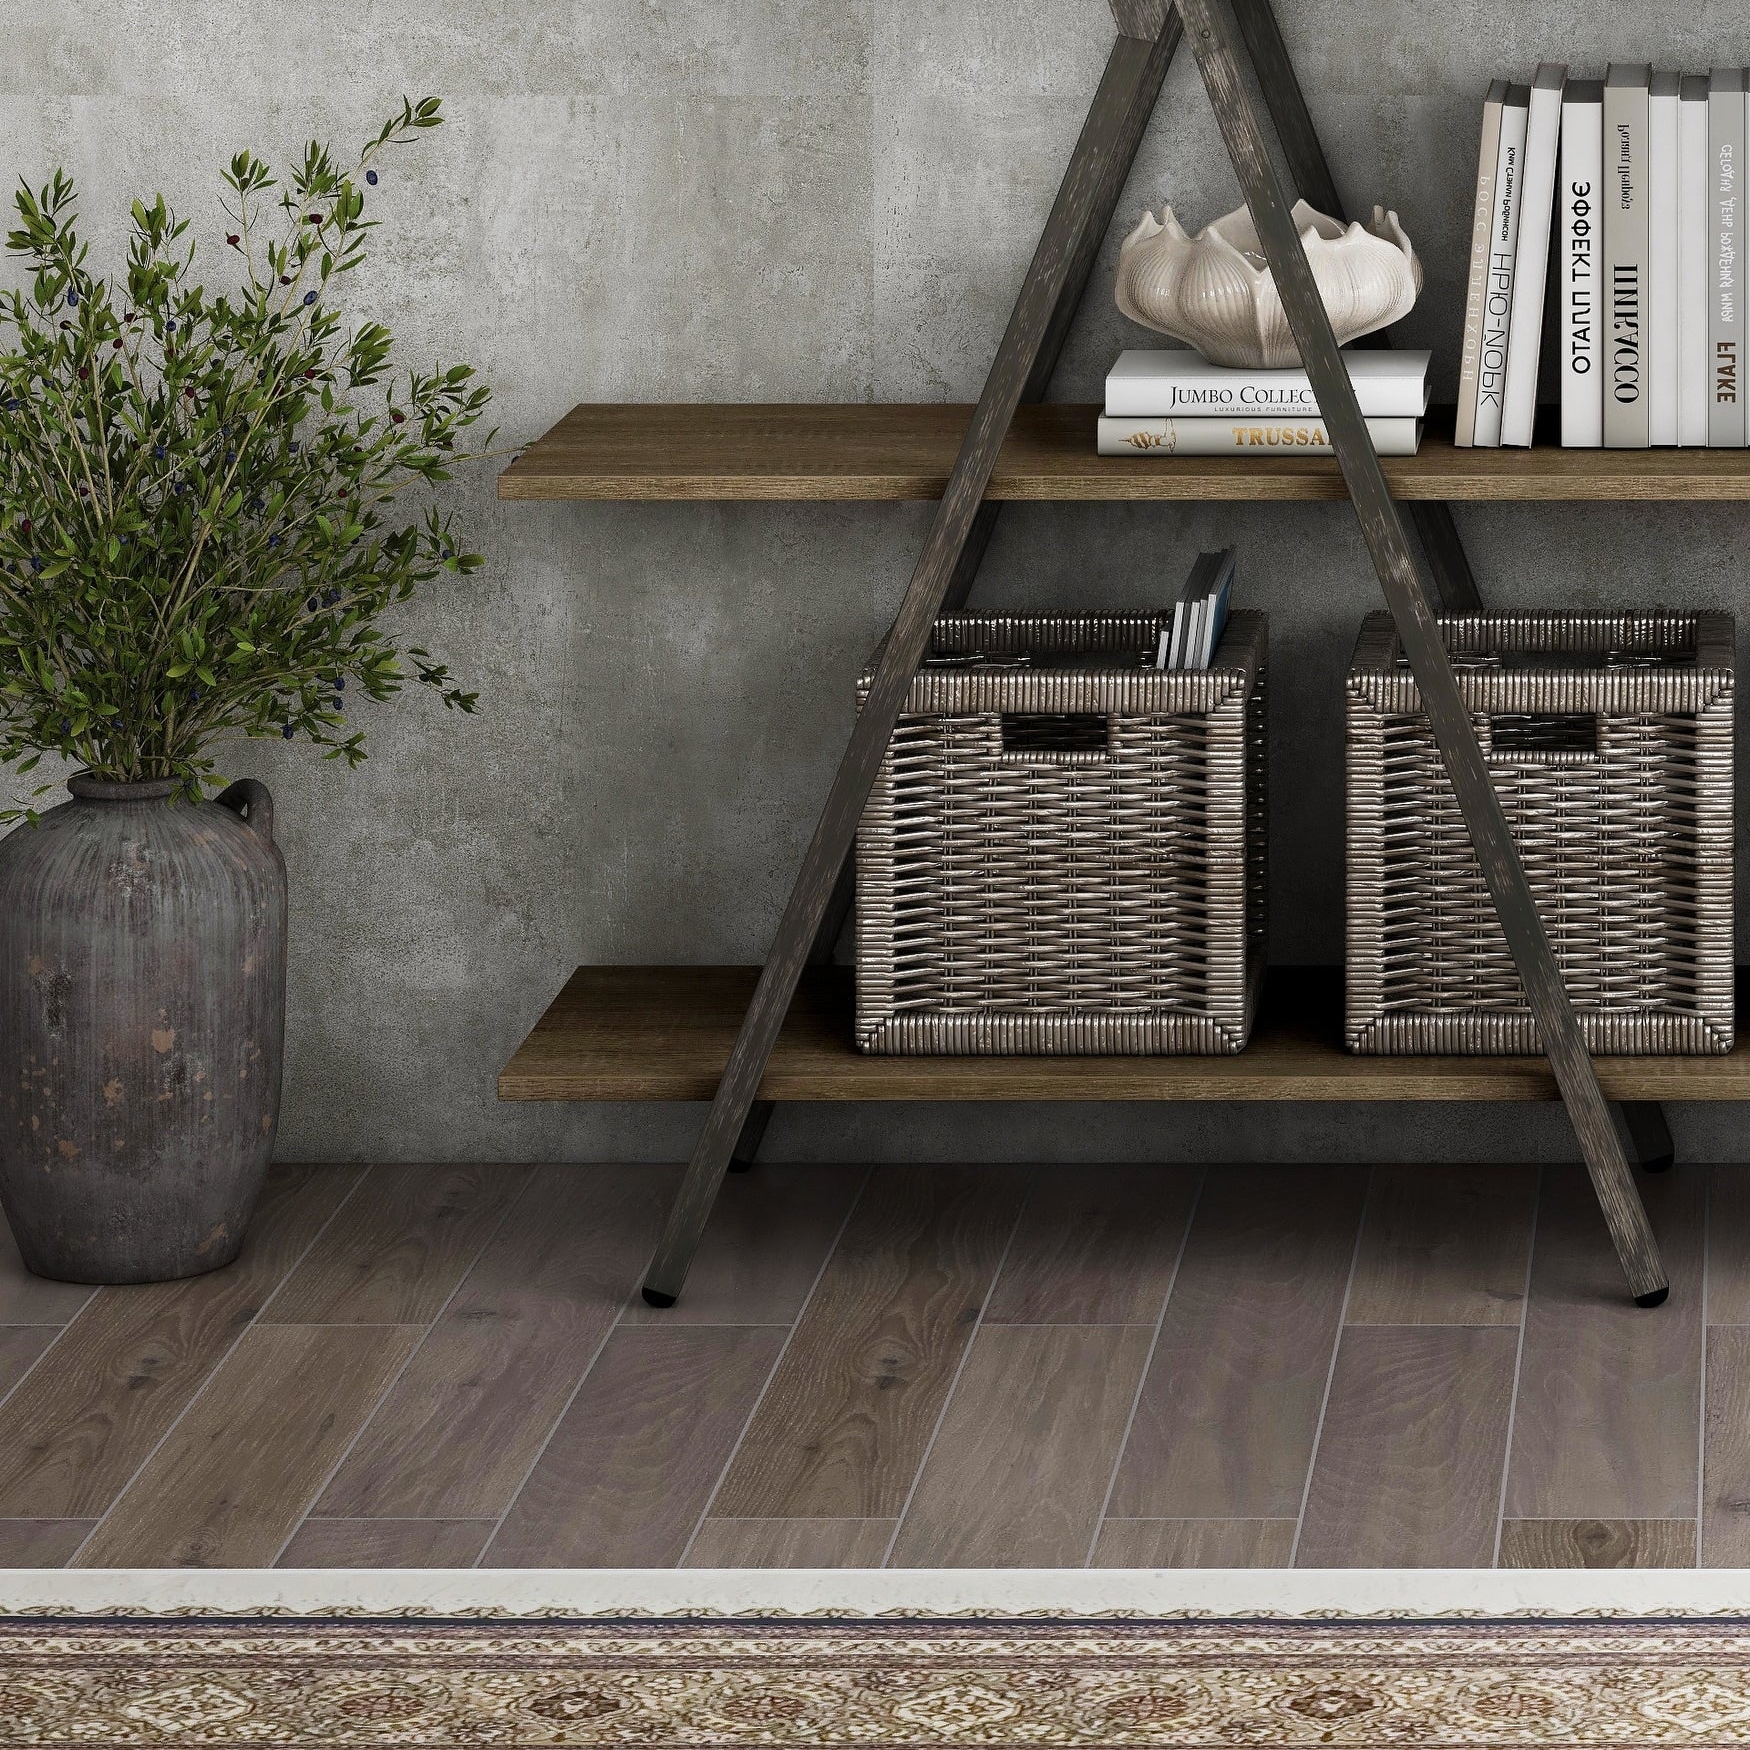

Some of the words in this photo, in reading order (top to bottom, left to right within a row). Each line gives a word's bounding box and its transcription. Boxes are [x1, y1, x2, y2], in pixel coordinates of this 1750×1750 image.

[1169, 386, 1233, 409] JUMBO
[1239, 385, 1356, 404] COLLEC
[1231, 427, 1332, 447] TRUSSA
